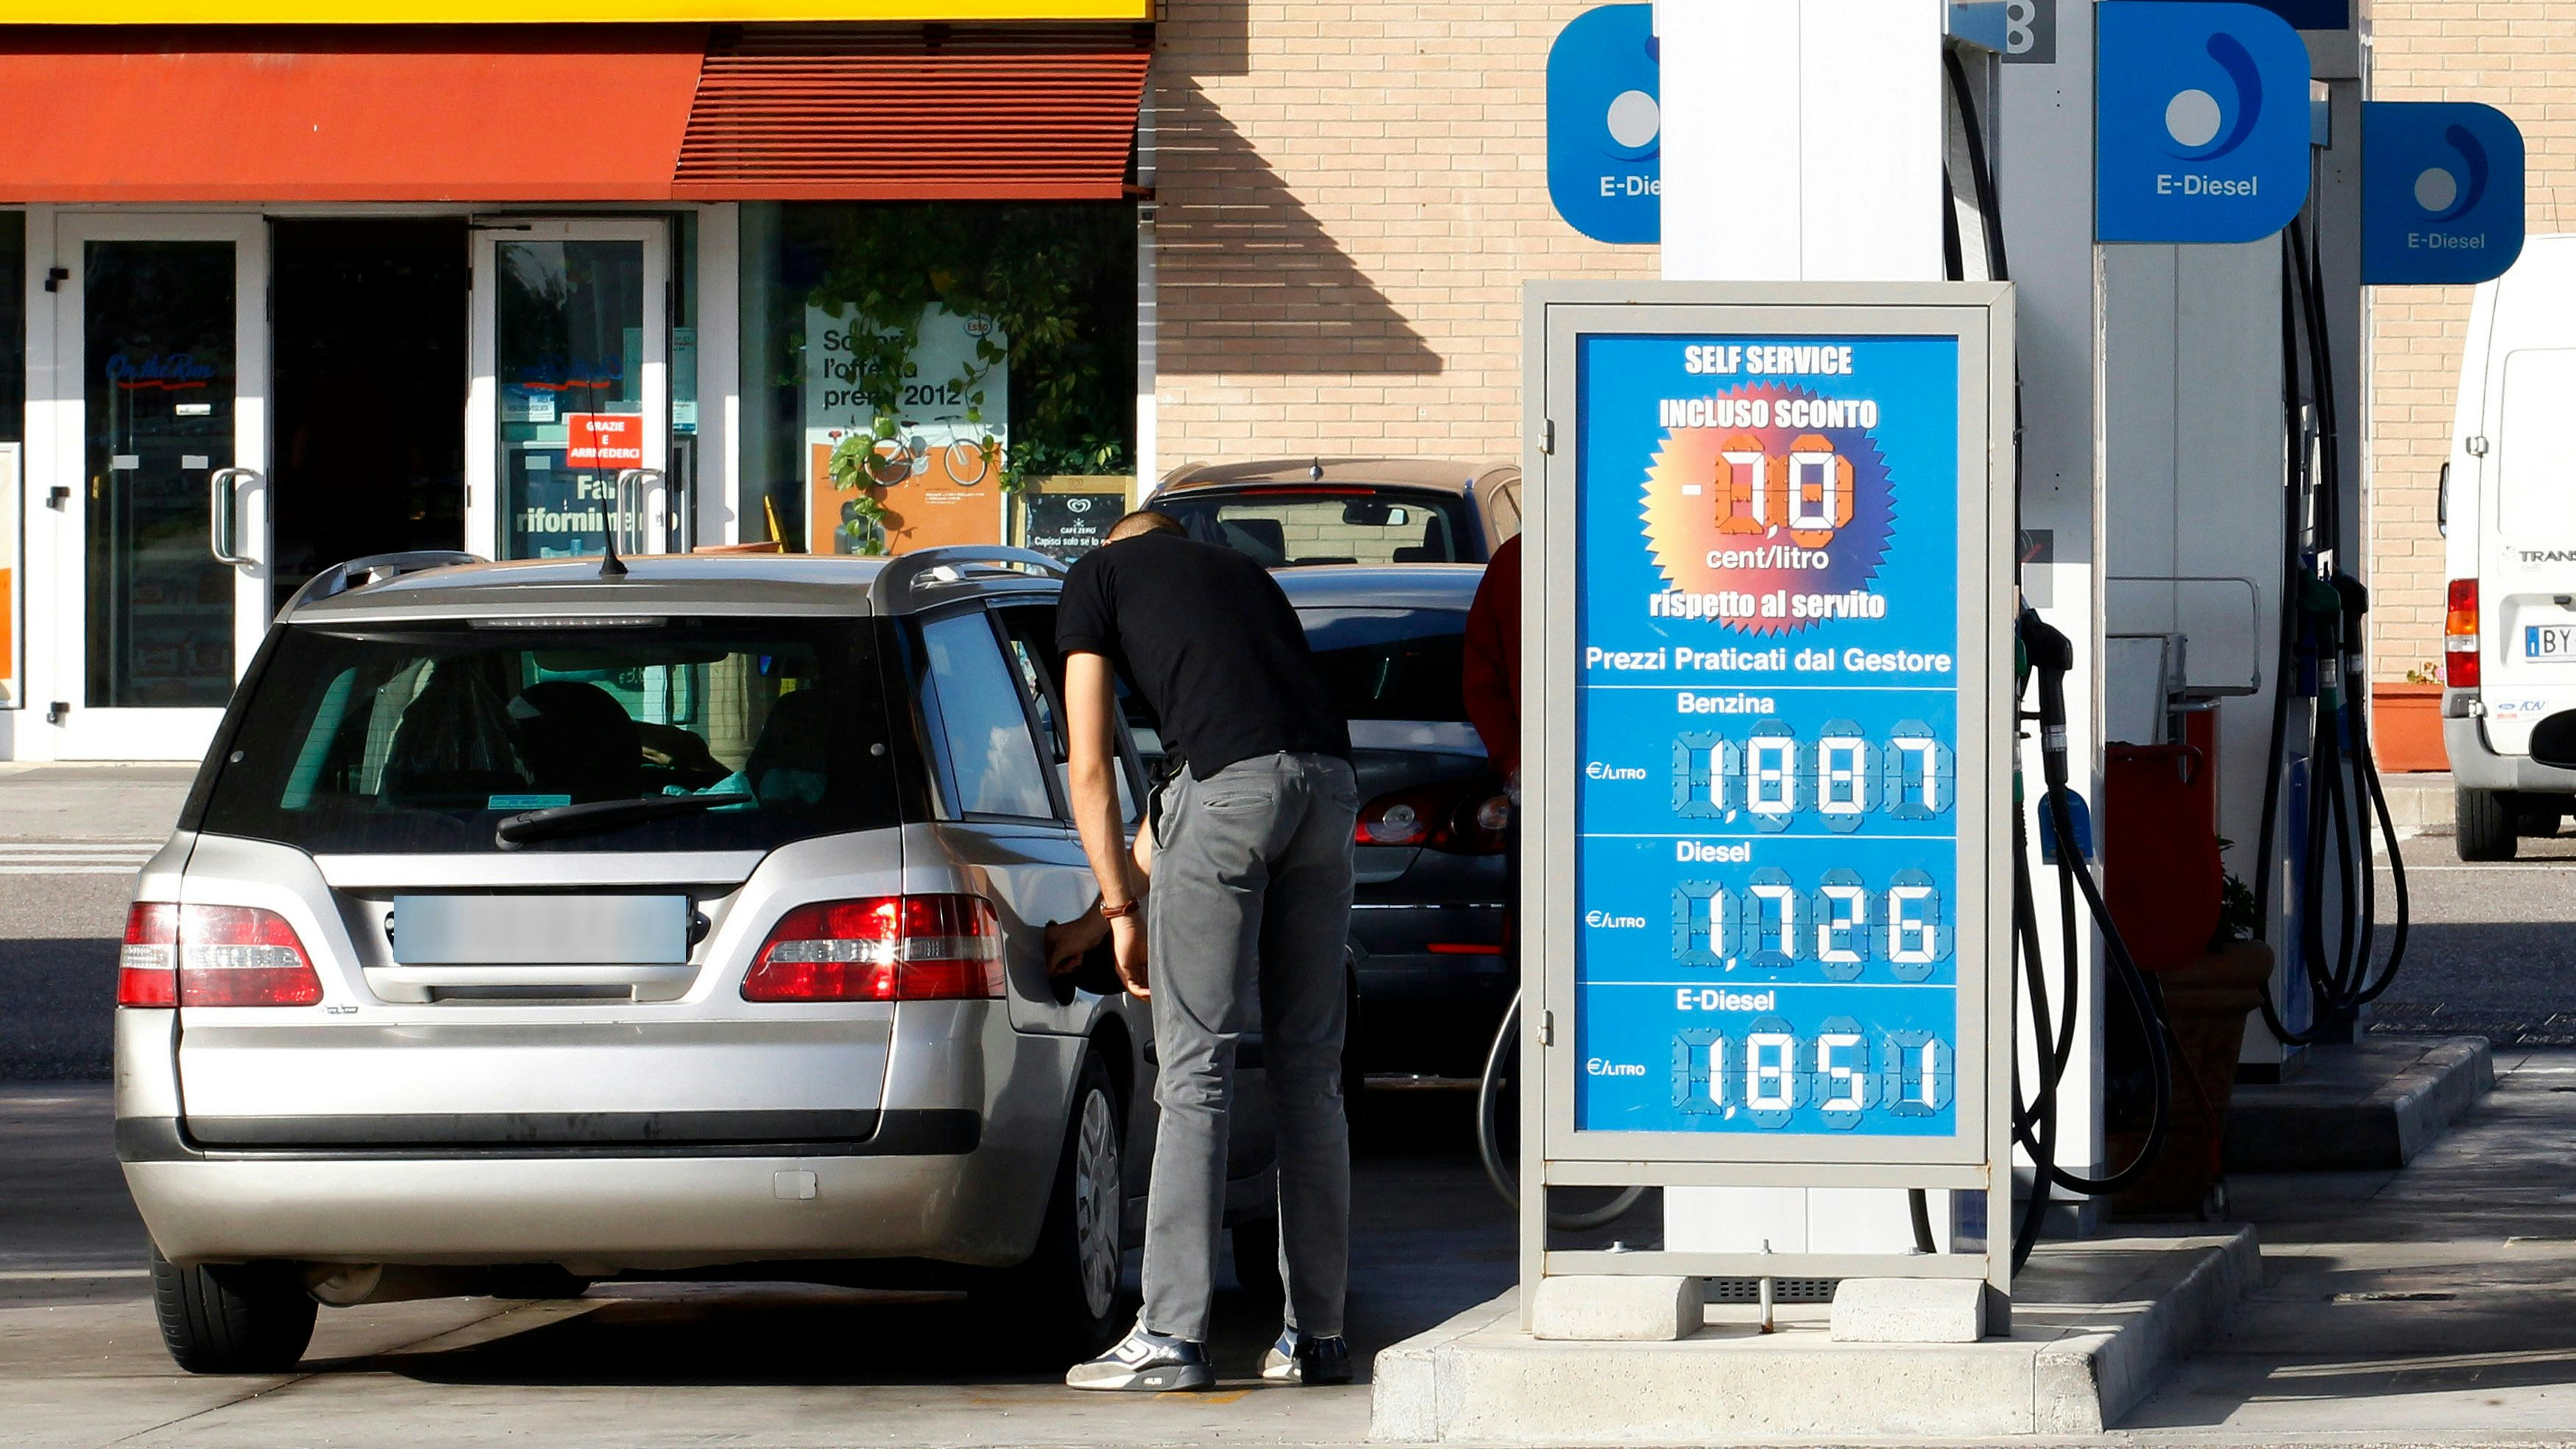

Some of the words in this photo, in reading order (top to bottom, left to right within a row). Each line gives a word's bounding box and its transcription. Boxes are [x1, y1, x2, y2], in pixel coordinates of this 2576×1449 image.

[2156, 175, 2257, 196] E-Diesel
[2407, 233, 2485, 249] E-Diesel
[1685, 346, 1741, 374] SELF
[1747, 346, 1852, 375] SERVICE
[904, 384, 961, 405] 2012
[1660, 399, 1769, 428] INCLUSO
[1774, 400, 1877, 428] SCONTO
[586, 421, 625, 432] GRAZIE
[602, 435, 609, 445] E
[570, 447, 640, 458] ARRIVEDERCI
[577, 474, 616, 500] Fai
[1034, 536, 1061, 548] Capisci
[1063, 536, 1079, 546] solo
[1081, 538, 1090, 546] se
[1091, 536, 1099, 546] lo
[1706, 545, 1829, 570] cent/litro
[1650, 589, 1755, 620] rispetto
[1761, 589, 1786, 617] al
[1791, 590, 1885, 618] servito
[2544, 629, 2571, 653] BY
[1586, 647, 1666, 670] Prezzi
[1675, 647, 1786, 671] Praticati
[1794, 648, 1835, 671] dal
[1843, 648, 1951, 673] Gestore
[1678, 692, 1774, 714] Benzina
[1586, 762, 1646, 780] €/LITRO
[1710, 736, 1936, 823] 1,887
[1677, 841, 1750, 862] Diesel
[1585, 910, 1646, 929] €/LITRO
[1710, 885, 1936, 972] 1,726
[1677, 989, 1774, 1011] E-Diesel
[1586, 1057, 1646, 1076] €/LITRO
[1710, 1033, 1936, 1120] 1,851
